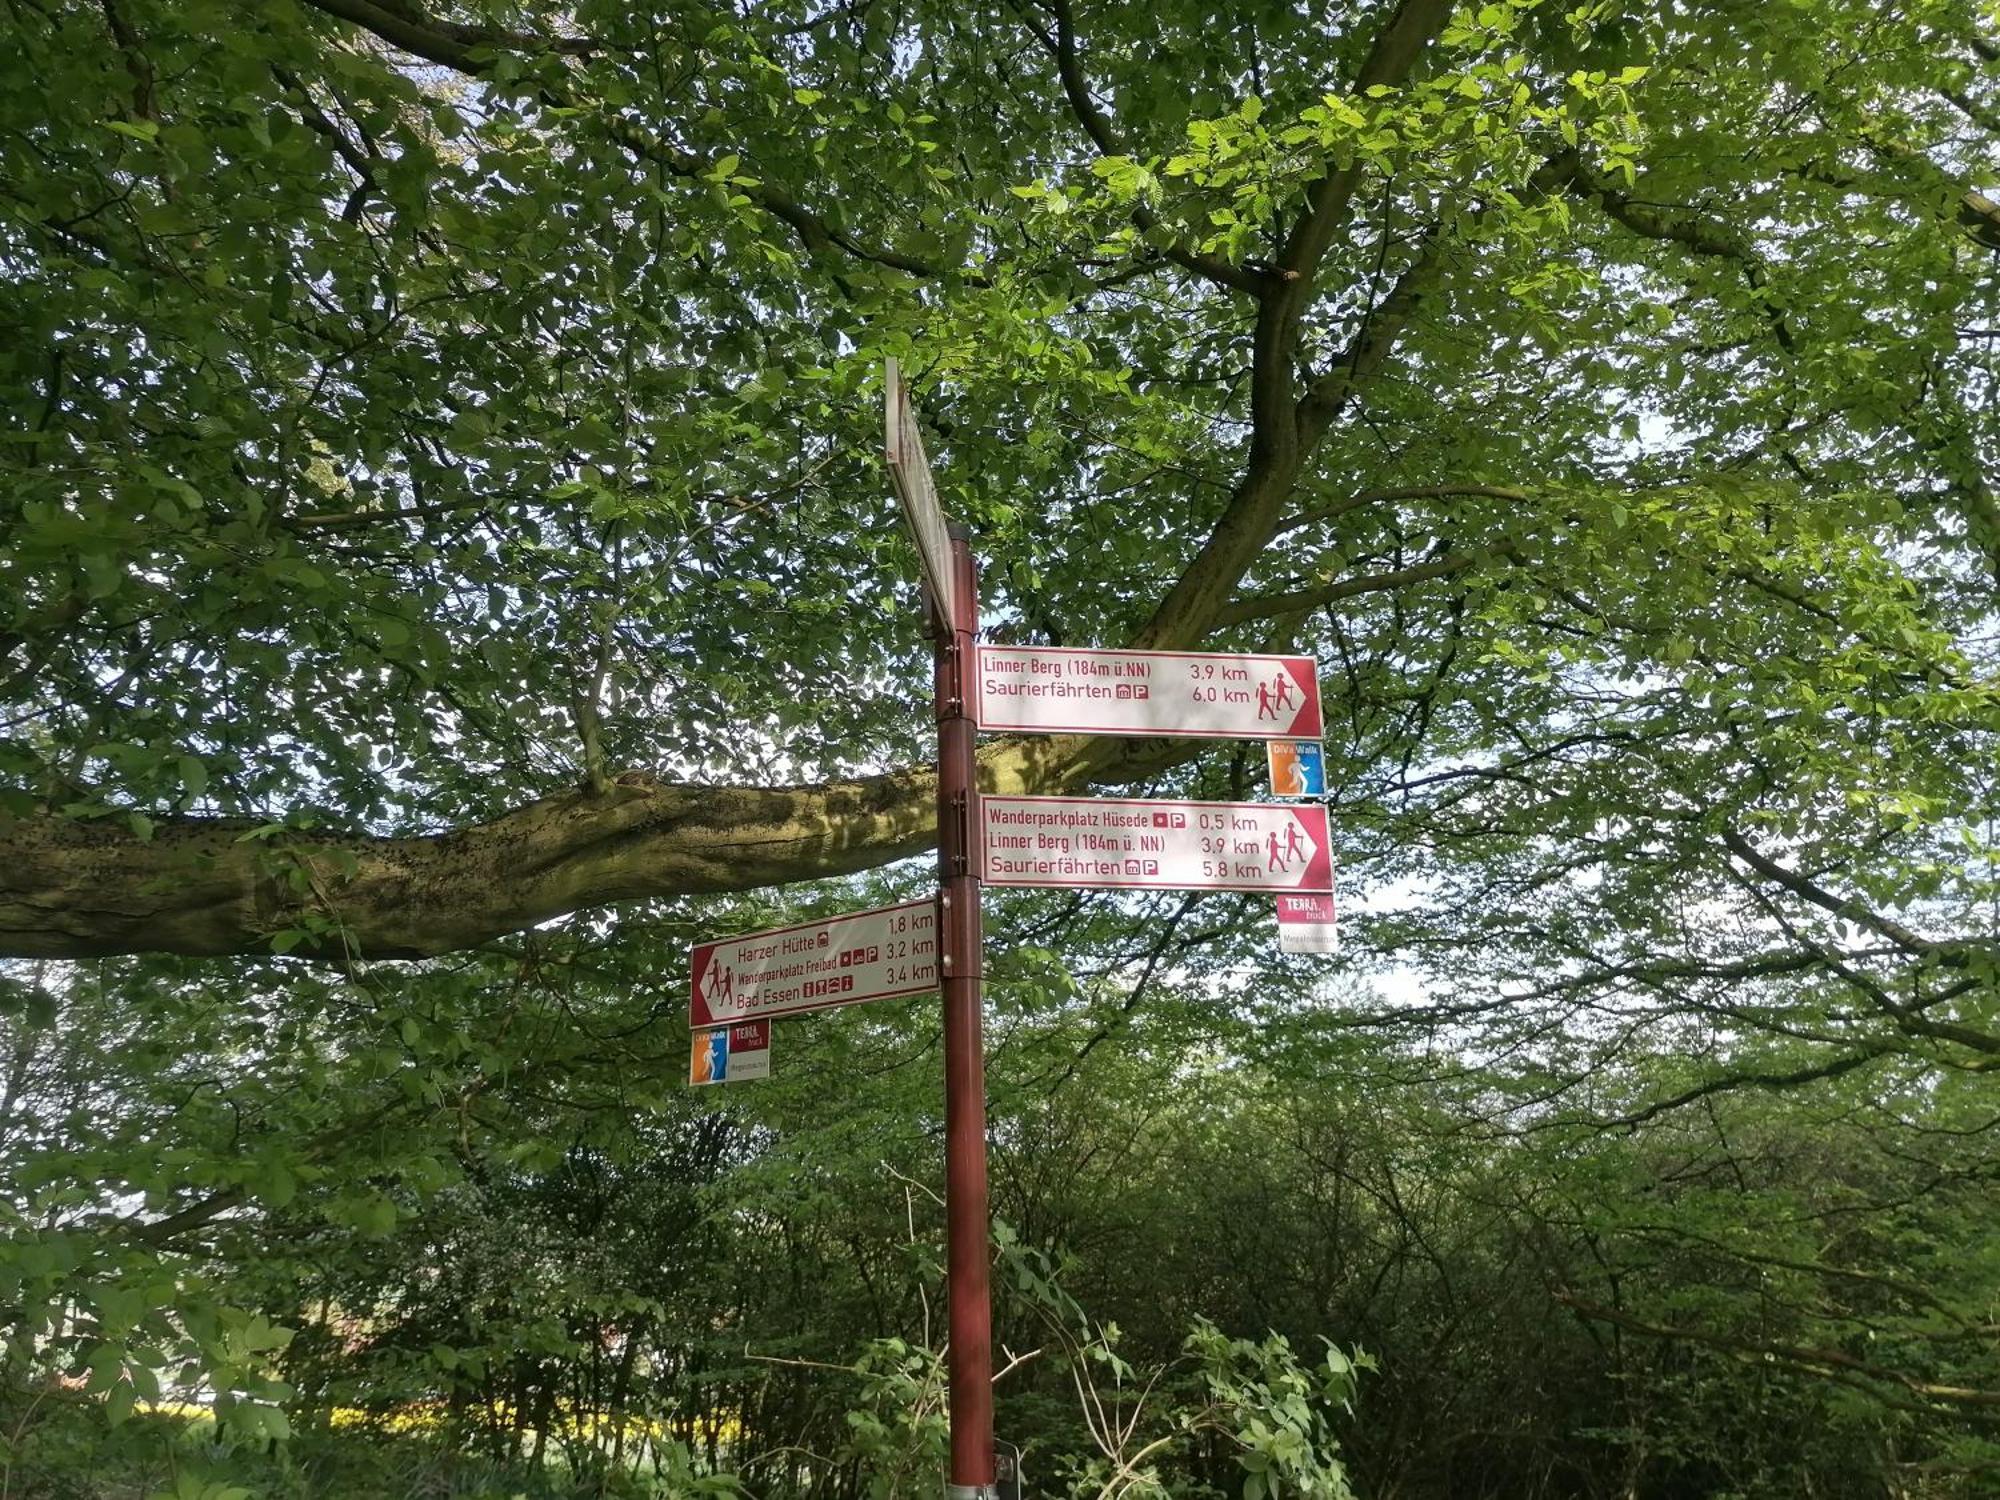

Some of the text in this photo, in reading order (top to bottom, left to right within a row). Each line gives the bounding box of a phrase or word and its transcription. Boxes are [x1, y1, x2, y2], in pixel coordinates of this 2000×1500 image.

[984, 656, 1025, 673] Linner
[1031, 658, 1062, 678] Berg
[1067, 658, 1110, 677] (184m
[1114, 661, 1151, 679] ü.NN)
[1222, 665, 1248, 681] km
[985, 679, 1112, 699] Saurierfährten
[1223, 687, 1250, 703] km
[989, 809, 1098, 829] Wanderparkplatz
[1102, 812, 1148, 828] Hüsede
[1231, 813, 1258, 831] km
[989, 832, 1032, 849] Linner
[1038, 834, 1069, 853] Berg
[1075, 835, 1119, 851] (184m
[1233, 837, 1260, 854] km
[991, 856, 1120, 875] Saurierfährten
[1235, 861, 1262, 879] km
[738, 943, 778, 963] Harzer
[782, 937, 814, 956] Hütte
[911, 914, 933, 931] km
[738, 963, 804, 986] Wanderparkplatz
[806, 955, 837, 974] Freibad
[912, 939, 934, 956] km
[737, 992, 760, 1010] Bad
[763, 987, 800, 1005] Essen
[912, 963, 934, 981] km
